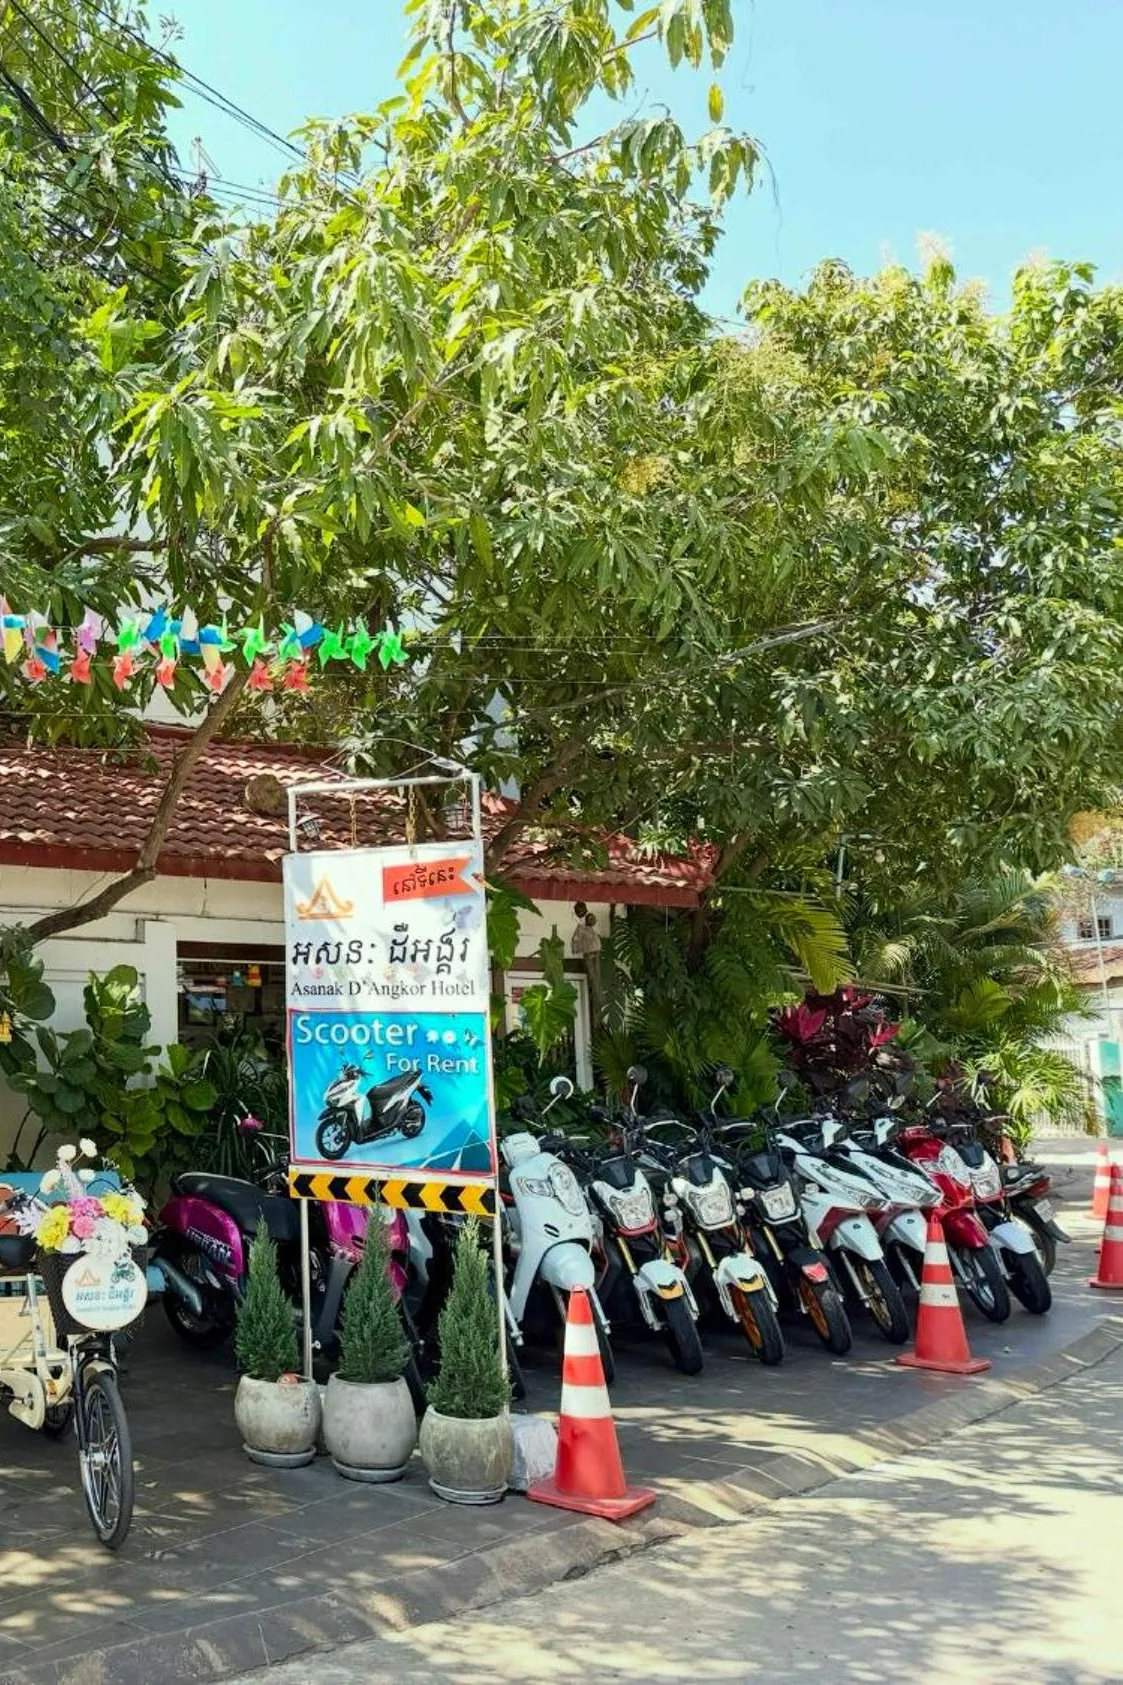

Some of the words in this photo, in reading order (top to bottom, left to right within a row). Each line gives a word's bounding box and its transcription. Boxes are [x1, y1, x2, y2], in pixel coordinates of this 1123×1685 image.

[291, 980, 344, 996] Asanak
[431, 979, 476, 996] Hotel
[296, 1016, 419, 1046] Scooter
[386, 1053, 420, 1072] For
[428, 1055, 479, 1074] Rent
